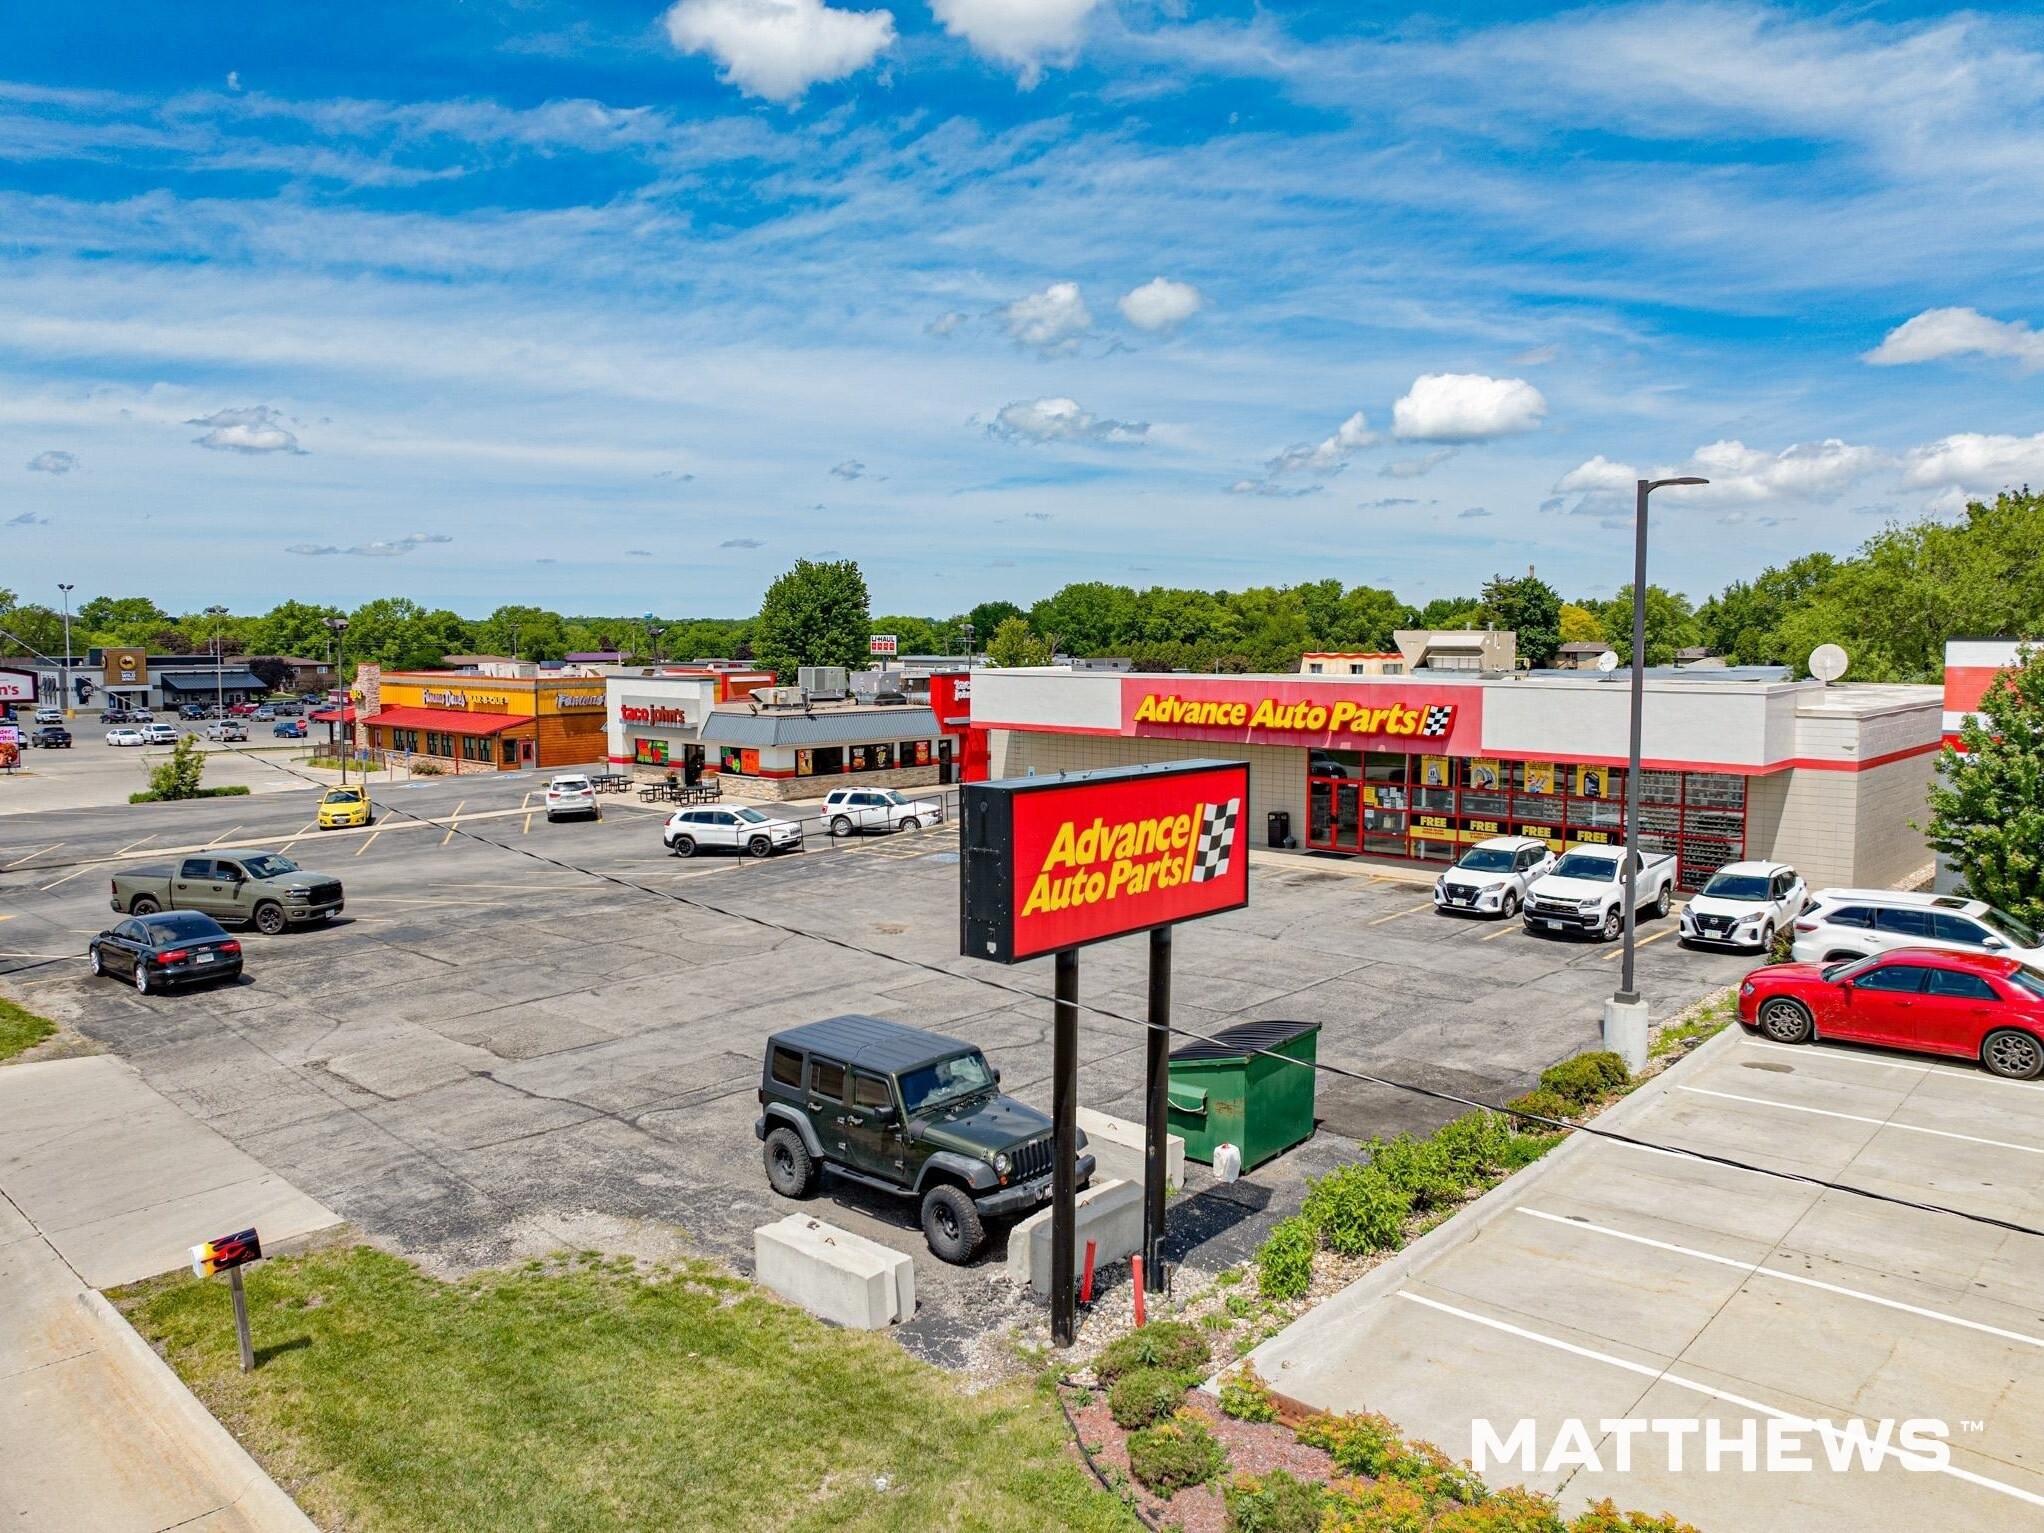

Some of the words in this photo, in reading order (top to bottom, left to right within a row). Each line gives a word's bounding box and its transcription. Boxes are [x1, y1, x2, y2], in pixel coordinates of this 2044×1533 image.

[620, 704, 649, 721] taco
[650, 704, 685, 726] john's
[1133, 694, 1247, 726] Advance
[1249, 698, 1328, 731] Auto
[1328, 701, 1418, 735] Parts
[1420, 815, 1447, 828] FREE
[1469, 820, 1498, 833] FREE
[1521, 824, 1551, 838] FREE
[1577, 830, 1608, 844] FREE
[1041, 813, 1191, 873] Advance
[1021, 871, 1105, 917] Auto
[1106, 851, 1183, 900] Parts
